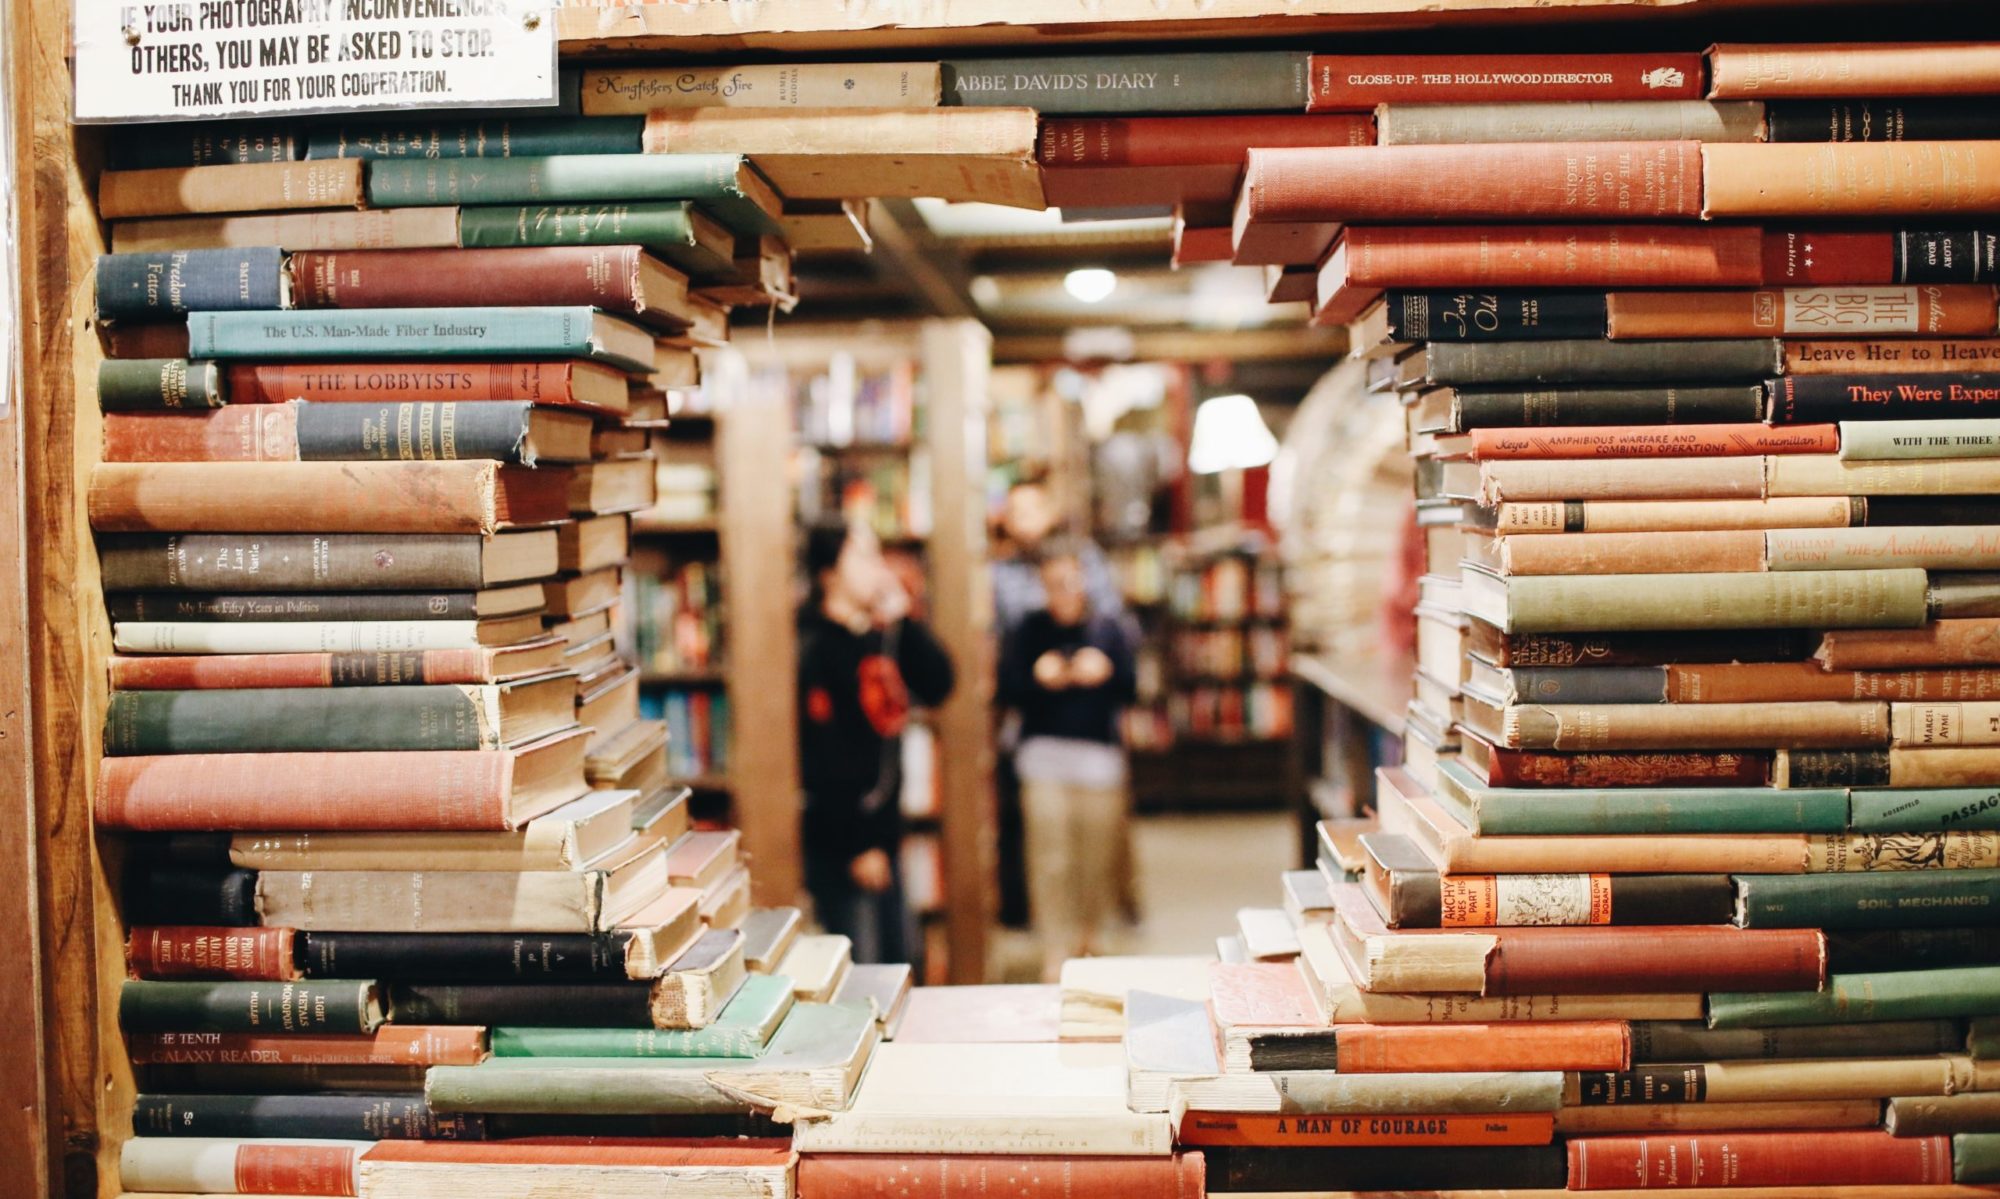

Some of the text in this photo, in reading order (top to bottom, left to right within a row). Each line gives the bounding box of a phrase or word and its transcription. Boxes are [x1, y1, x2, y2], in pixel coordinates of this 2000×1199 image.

[145, 3, 193, 33] YOUR
[200, 0, 331, 30] PHOTOGRAPHY
[132, 29, 494, 74] OTHERS, YOU MAY BE ASKED TO STOP.
[172, 70, 452, 107] THANK YOU FOR YOUR COOPERATION.
[597, 74, 753, 99] Kingfishers Catch Fire
[955, 73, 1157, 91] ABBE DAVID'S DIARY
[1348, 72, 1613, 86] CLOSE-UP: THE HOLLYWOOD DIRECTOR
[1566, 157, 1577, 206] BEGINS
[1585, 154, 1597, 207] REASON
[1601, 171, 1613, 190] OF
[1618, 152, 1630, 209] THE AGE
[1787, 233, 1796, 277] Doubleday
[1928, 240, 1937, 266] ROAD
[1943, 238, 1951, 269] GLORY
[239, 262, 249, 301] SMITH
[1521, 300, 1529, 326] MARY
[1793, 294, 1831, 327] SKY
[1834, 294, 1868, 326] BIG
[1873, 292, 1915, 325] THE
[263, 324, 487, 339] The U.S. Man-Made Fiber Industry
[1800, 345, 1855, 361] Leave
[1867, 345, 1900, 360] Her
[1912, 347, 1930, 360] to
[160, 363, 173, 405] COLUMBIA
[177, 369, 188, 398] PRESS
[301, 373, 472, 391] THE LOBBYISTS
[1848, 386, 1892, 404] They
[1897, 385, 1942, 401] Were
[421, 406, 432, 425] AND
[442, 405, 454, 420] THE
[1496, 438, 1530, 453] Keyes
[1549, 436, 1614, 446] AMPHIBIOUS
[1620, 435, 1668, 444] WARFARE
[1672, 434, 1697, 443] AND
[1596, 443, 1727, 454] COMBINED OPERATIONS
[1893, 436, 1992, 446] WITH THE THREE
[1777, 538, 1836, 550] WILLIAM
[1784, 551, 1830, 561] GAUNT
[216, 547, 228, 570] The
[233, 547, 243, 571] Last
[222, 602, 245, 617] Fifty
[247, 602, 272, 614] Years
[274, 602, 285, 613] in
[287, 601, 319, 614] Politics
[1923, 708, 1933, 743] MARCEL
[1882, 793, 2000, 826] ROSENFELD PASSAG
[1825, 833, 1835, 872] ROBER
[1838, 834, 1847, 872] NATHA
[1457, 880, 1466, 895] HIS
[1443, 880, 1455, 920] ARCHY
[1469, 889, 1477, 913] PART
[1592, 878, 1600, 923] DOUBLEDAY
[1857, 898, 1893, 910] SOIL
[1898, 895, 1990, 908] MECHANICS
[161, 940, 172, 963] DIETZ
[528, 953, 537, 962] of
[249, 991, 260, 1025] MULLER
[280, 984, 294, 1031] MONOPOLY
[297, 990, 310, 1028] METALS
[314, 995, 326, 1023] LIGHT
[1459, 999, 1468, 1013] of
[179, 1033, 221, 1044] TENTH
[409, 1040, 419, 1055] Sc
[152, 1050, 282, 1063] GALAXY READER
[1592, 1082, 1600, 1097] The
[183, 1111, 193, 1126] Sc
[1277, 1119, 1447, 1135] A MAN OF COURAGE
